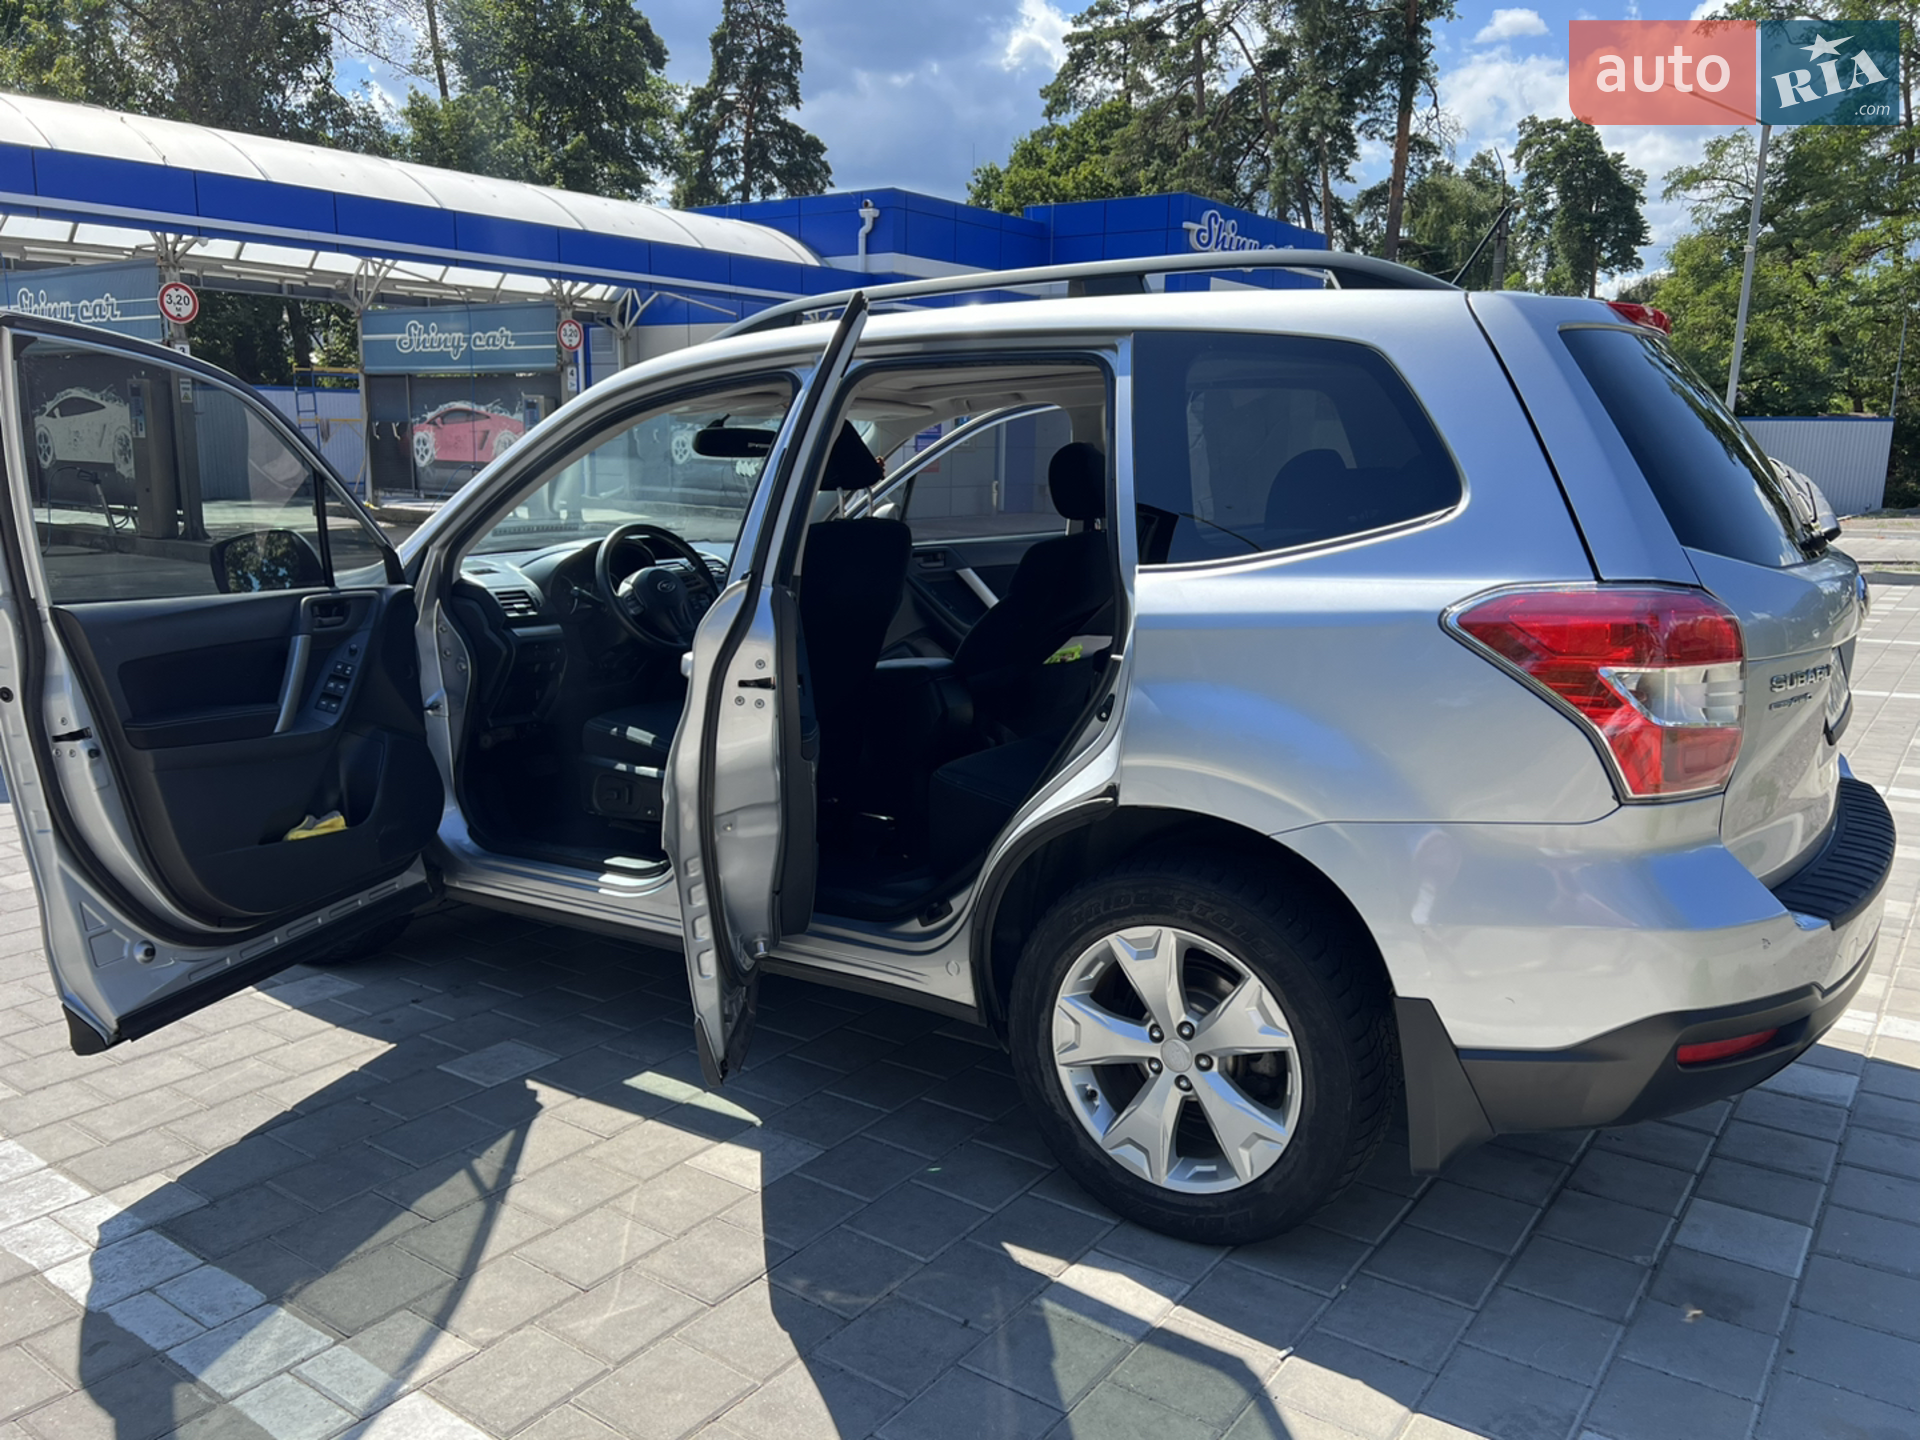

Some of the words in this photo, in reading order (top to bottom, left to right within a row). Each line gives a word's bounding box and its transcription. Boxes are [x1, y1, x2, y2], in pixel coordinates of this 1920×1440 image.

[78, 293, 121, 323] car
[166, 293, 190, 307] 3,20
[396, 320, 467, 360] Shiny
[471, 327, 515, 350] car
[569, 369, 574, 377] 4
